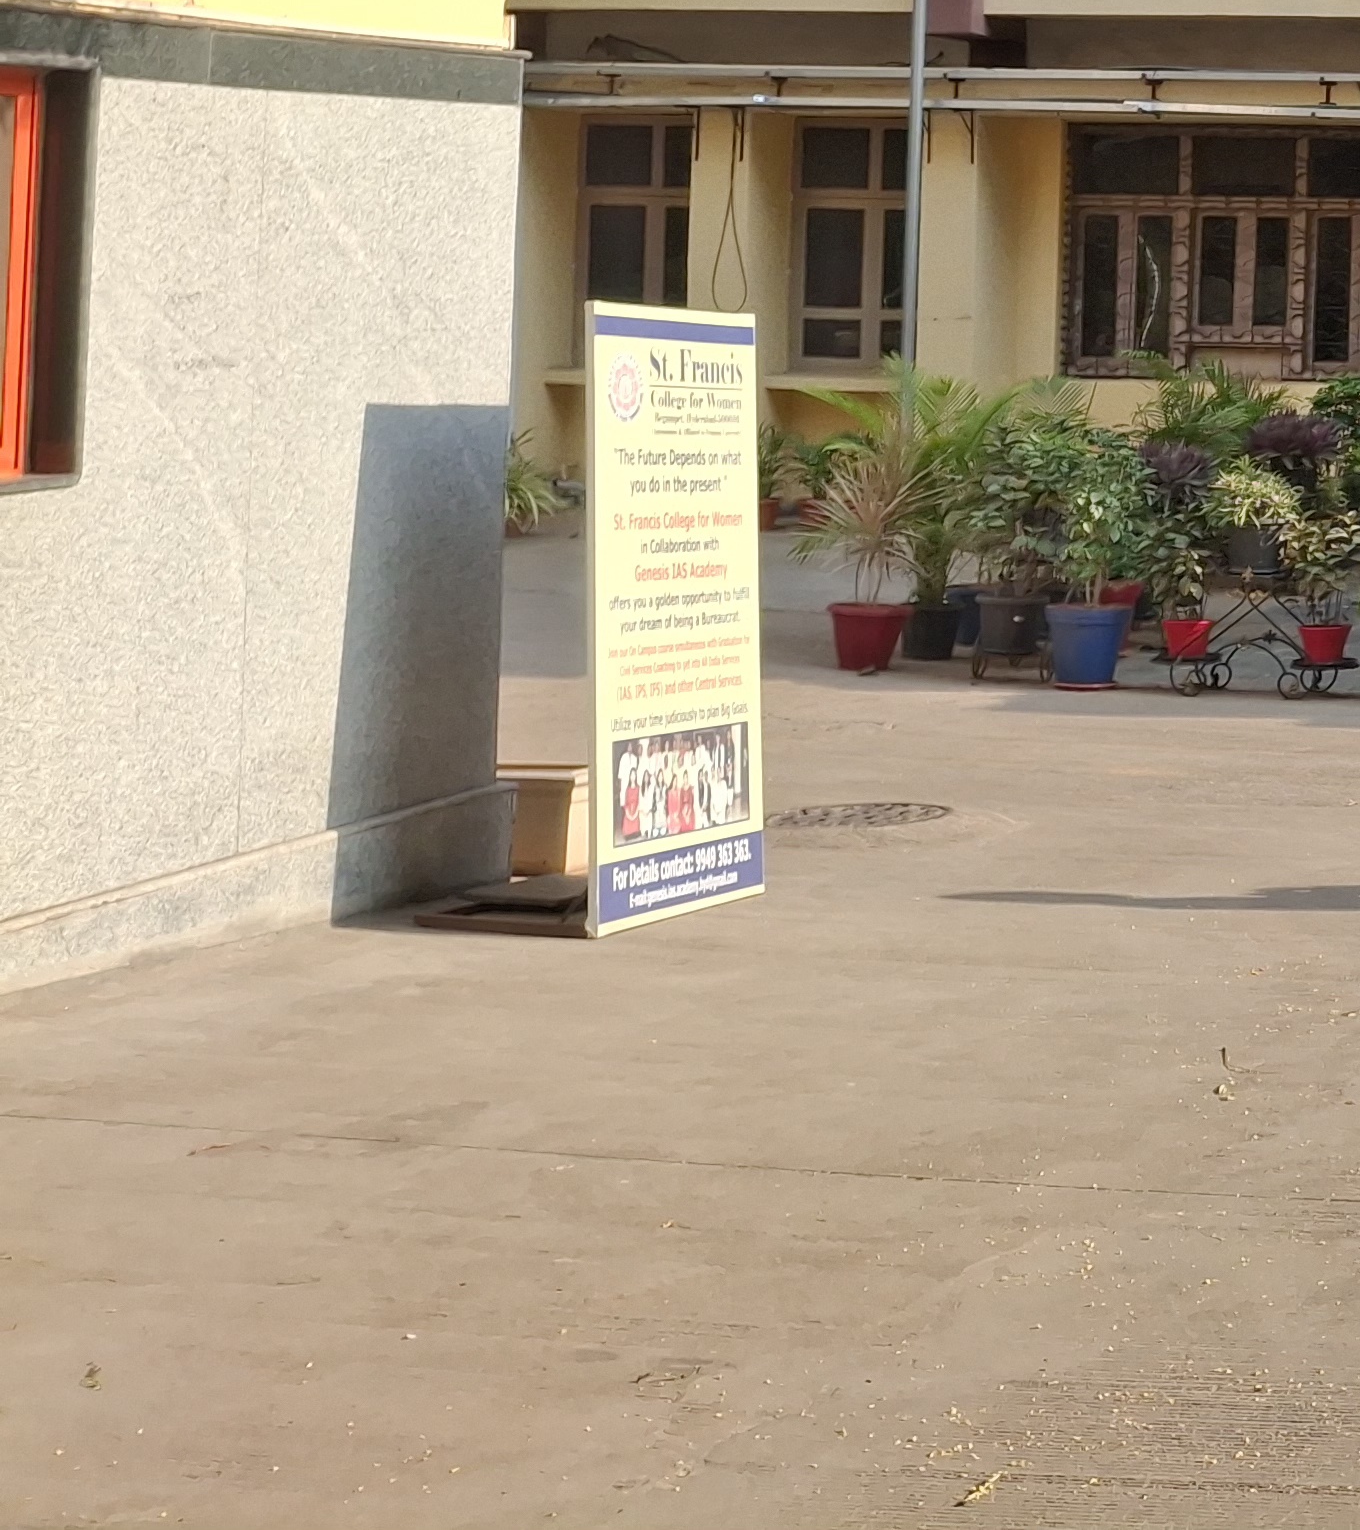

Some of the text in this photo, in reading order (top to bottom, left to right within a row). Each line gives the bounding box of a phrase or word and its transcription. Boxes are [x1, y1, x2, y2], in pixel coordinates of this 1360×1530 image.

[649, 346, 743, 385] St. Francis
[650, 390, 742, 410] College for Women
[638, 449, 667, 466] Future
[669, 449, 706, 469] Depends
[708, 452, 718, 466] on
[721, 450, 742, 466] what
[630, 479, 646, 497] you
[649, 476, 660, 493] do
[662, 476, 670, 492] in
[673, 476, 687, 492] the
[629, 512, 661, 530] Francis
[663, 511, 695, 532] College
[697, 511, 709, 528] for
[712, 511, 743, 527] Women
[641, 536, 720, 554] in Collaboration with
[635, 560, 728, 582] Genesis IAS Academy
[609, 595, 631, 611] offers
[633, 597, 647, 612] you
[655, 592, 680, 611] golden
[681, 590, 722, 608] opportunity
[723, 589, 731, 602] to
[620, 619, 637, 636] your
[639, 616, 663, 631] dream
[664, 614, 672, 629] of
[673, 613, 694, 630] being
[613, 866, 628, 891] For
[629, 858, 660, 888] Details
[660, 852, 694, 880] contact:
[695, 845, 716, 872] 9949
[718, 841, 733, 868] 363
